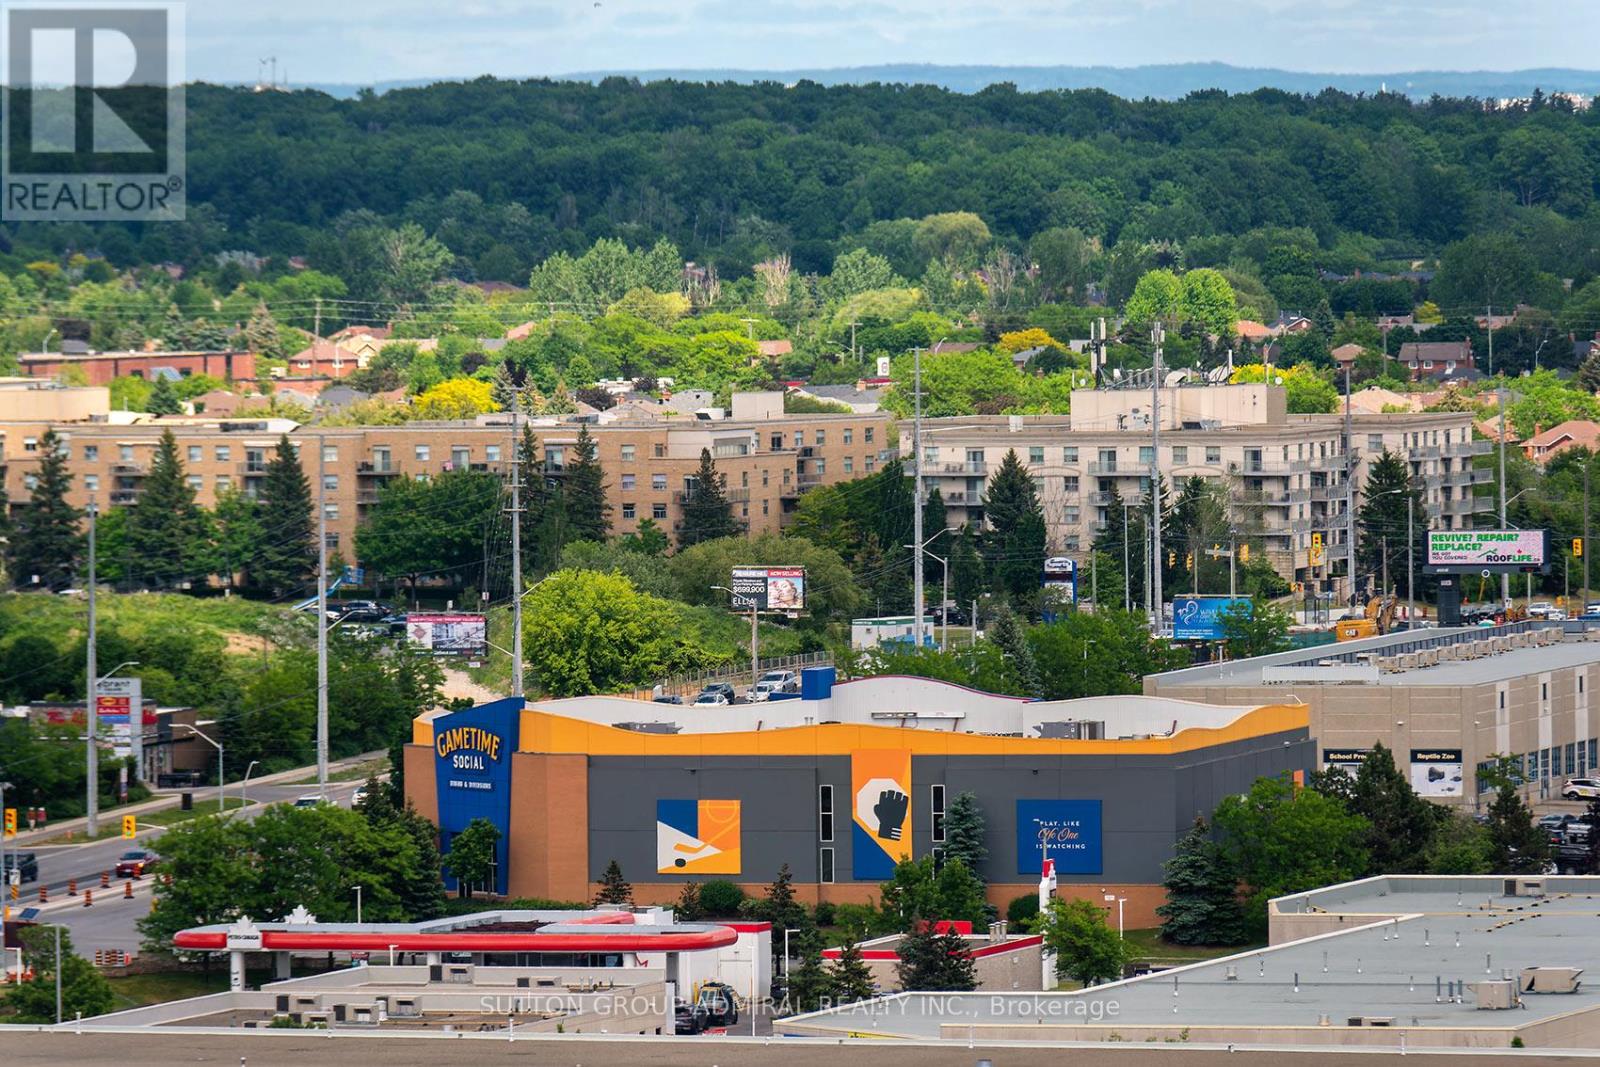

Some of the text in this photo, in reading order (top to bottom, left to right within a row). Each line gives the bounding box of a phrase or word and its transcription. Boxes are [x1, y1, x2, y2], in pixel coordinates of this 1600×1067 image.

[1431, 533, 1519, 542] REVIVE? REPAIR?
[1431, 543, 1483, 551] REPLACE?
[437, 727, 500, 760] GAMETIME
[453, 754, 484, 770] SOCIAL
[1057, 828, 1079, 841] One
